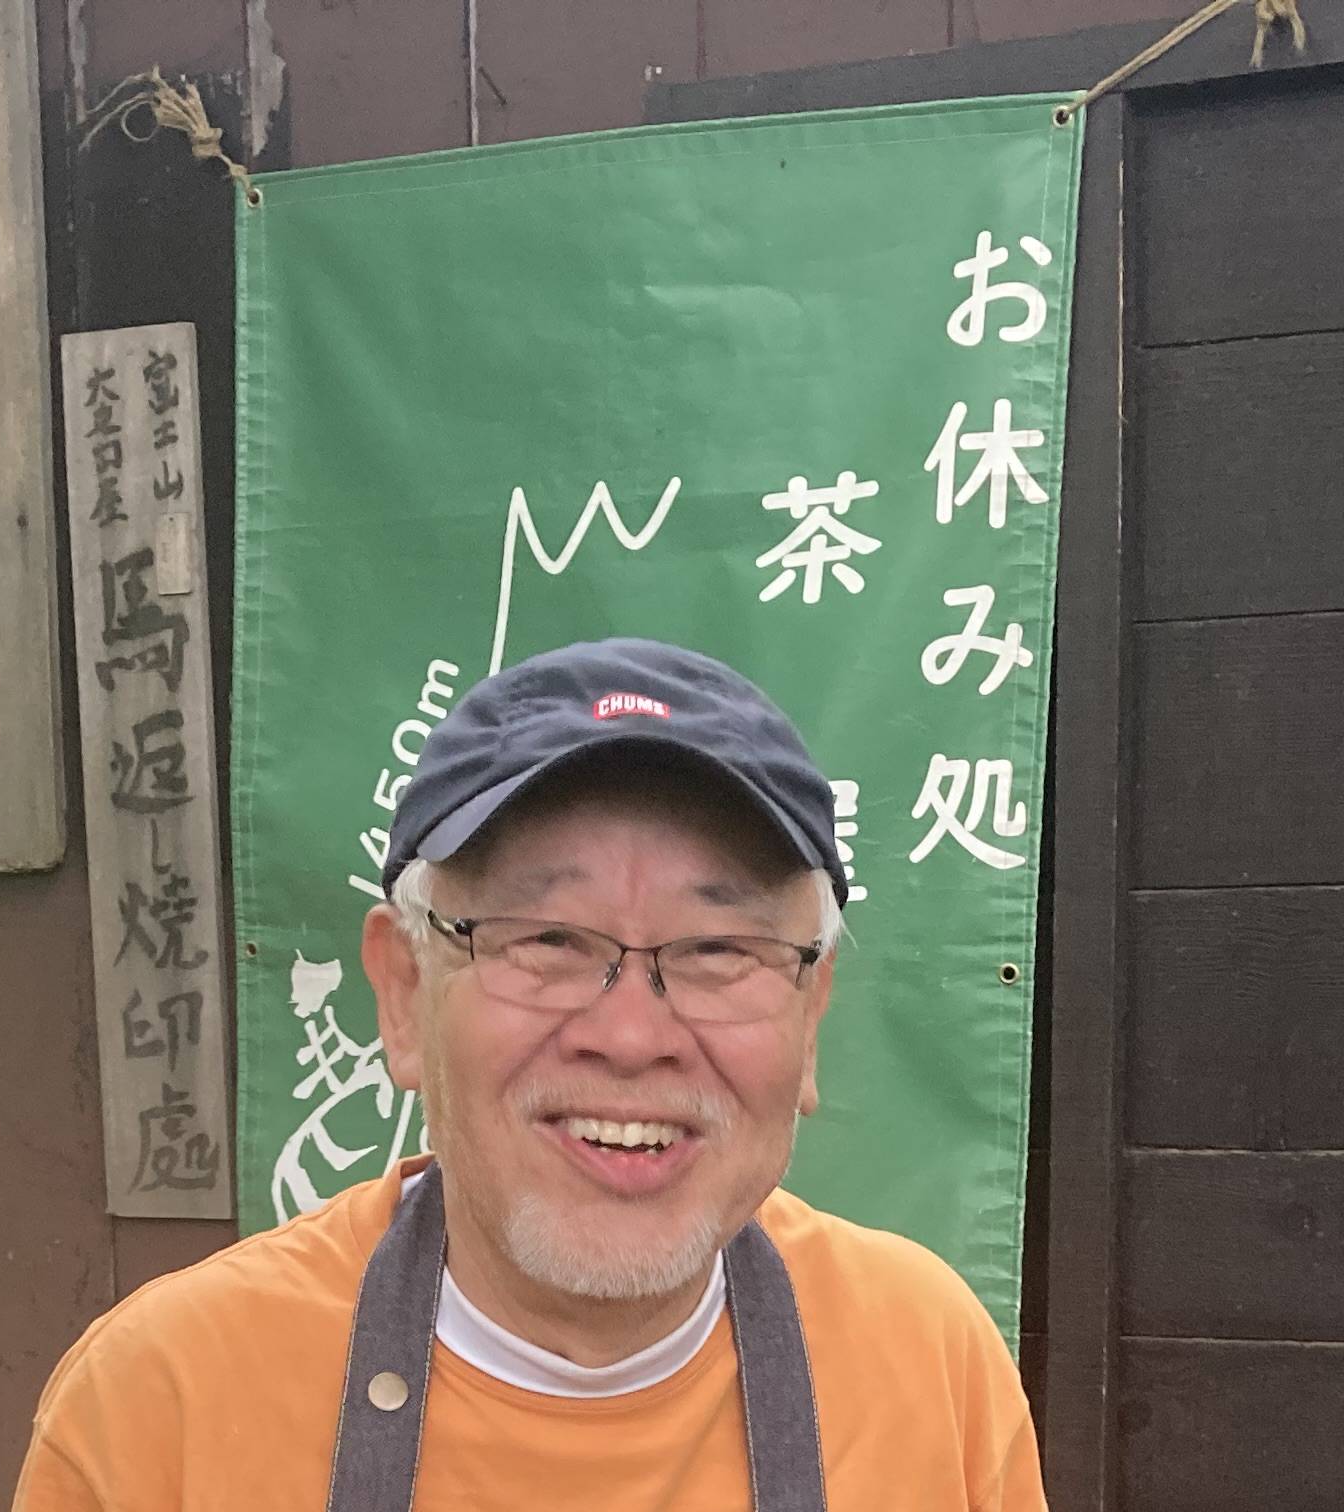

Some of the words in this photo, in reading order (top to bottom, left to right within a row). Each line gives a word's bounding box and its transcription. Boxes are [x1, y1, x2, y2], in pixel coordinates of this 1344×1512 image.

[598, 695, 665, 716] CHUMS
[909, 230, 1052, 869] お休み処
